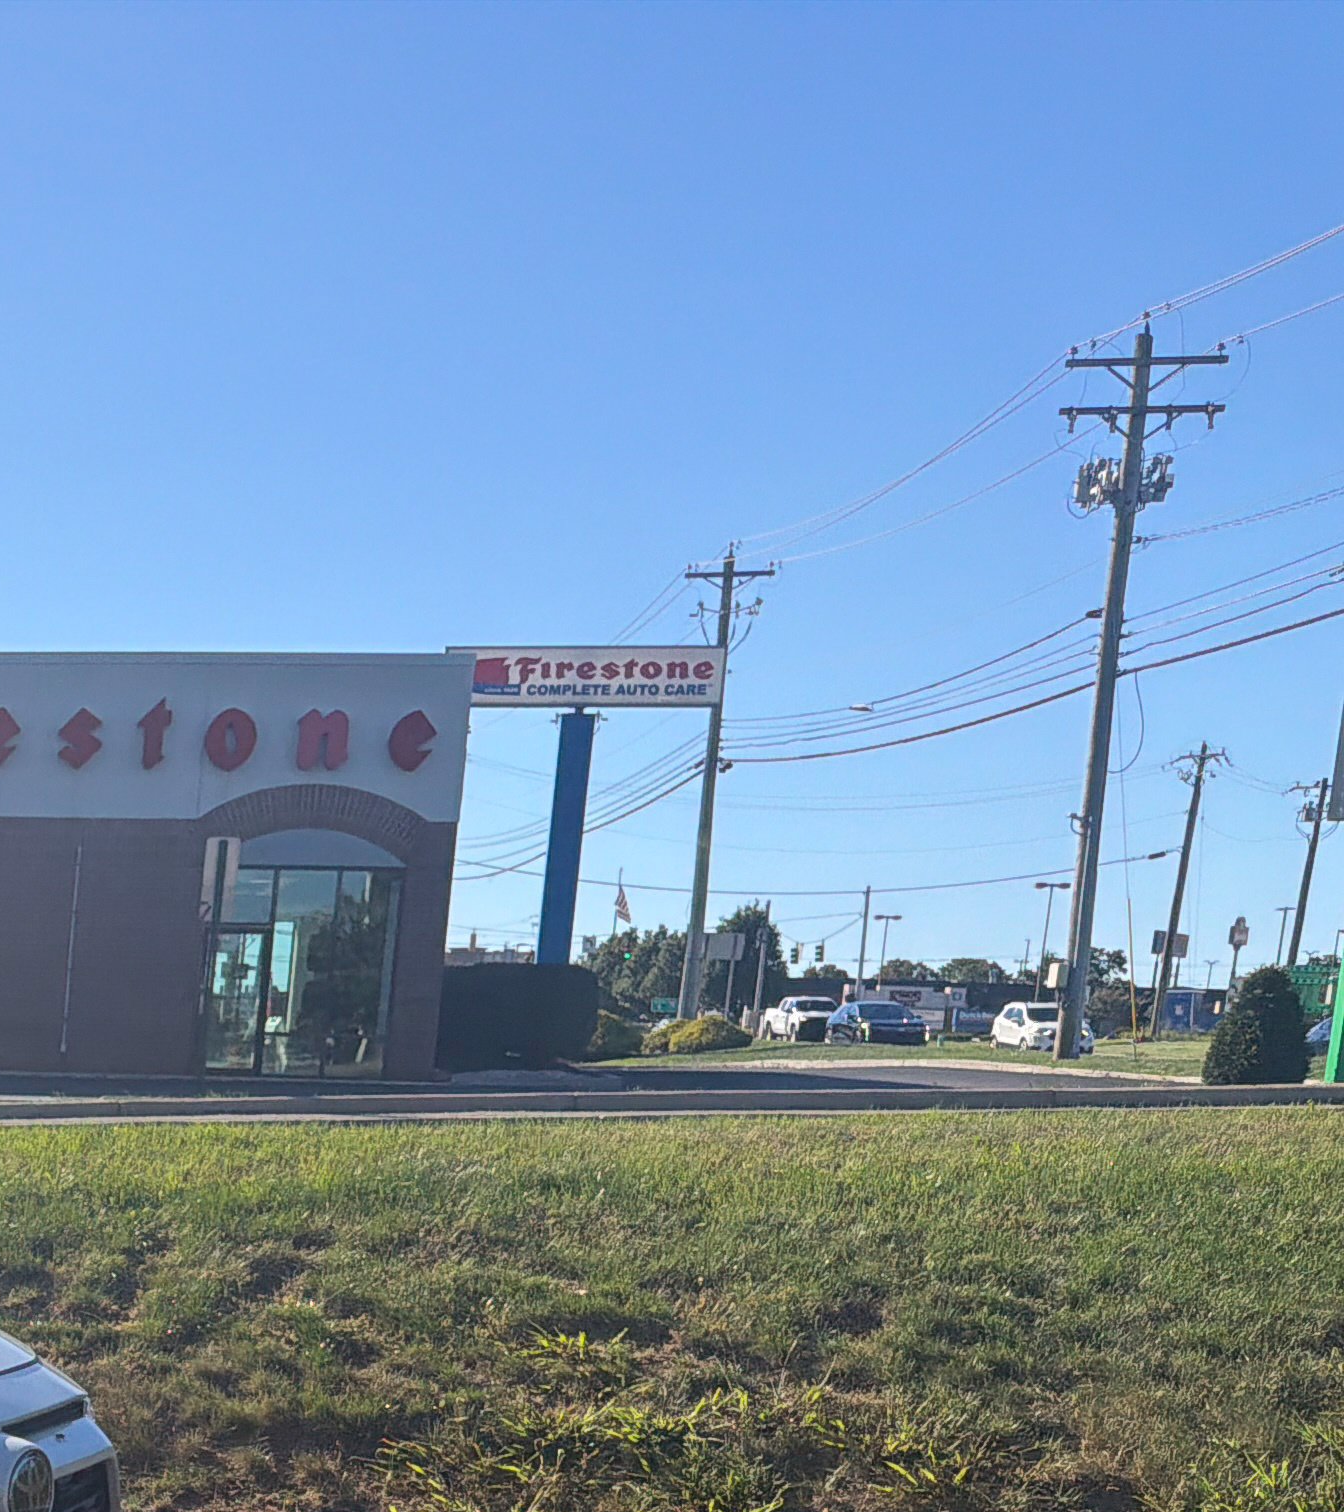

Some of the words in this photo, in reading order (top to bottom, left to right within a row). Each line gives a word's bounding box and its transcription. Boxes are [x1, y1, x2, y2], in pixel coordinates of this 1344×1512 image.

[514, 656, 714, 684] Firestone
[527, 684, 611, 696] COMPLETE
[616, 684, 659, 696] AUTO
[664, 685, 708, 697] CARE
